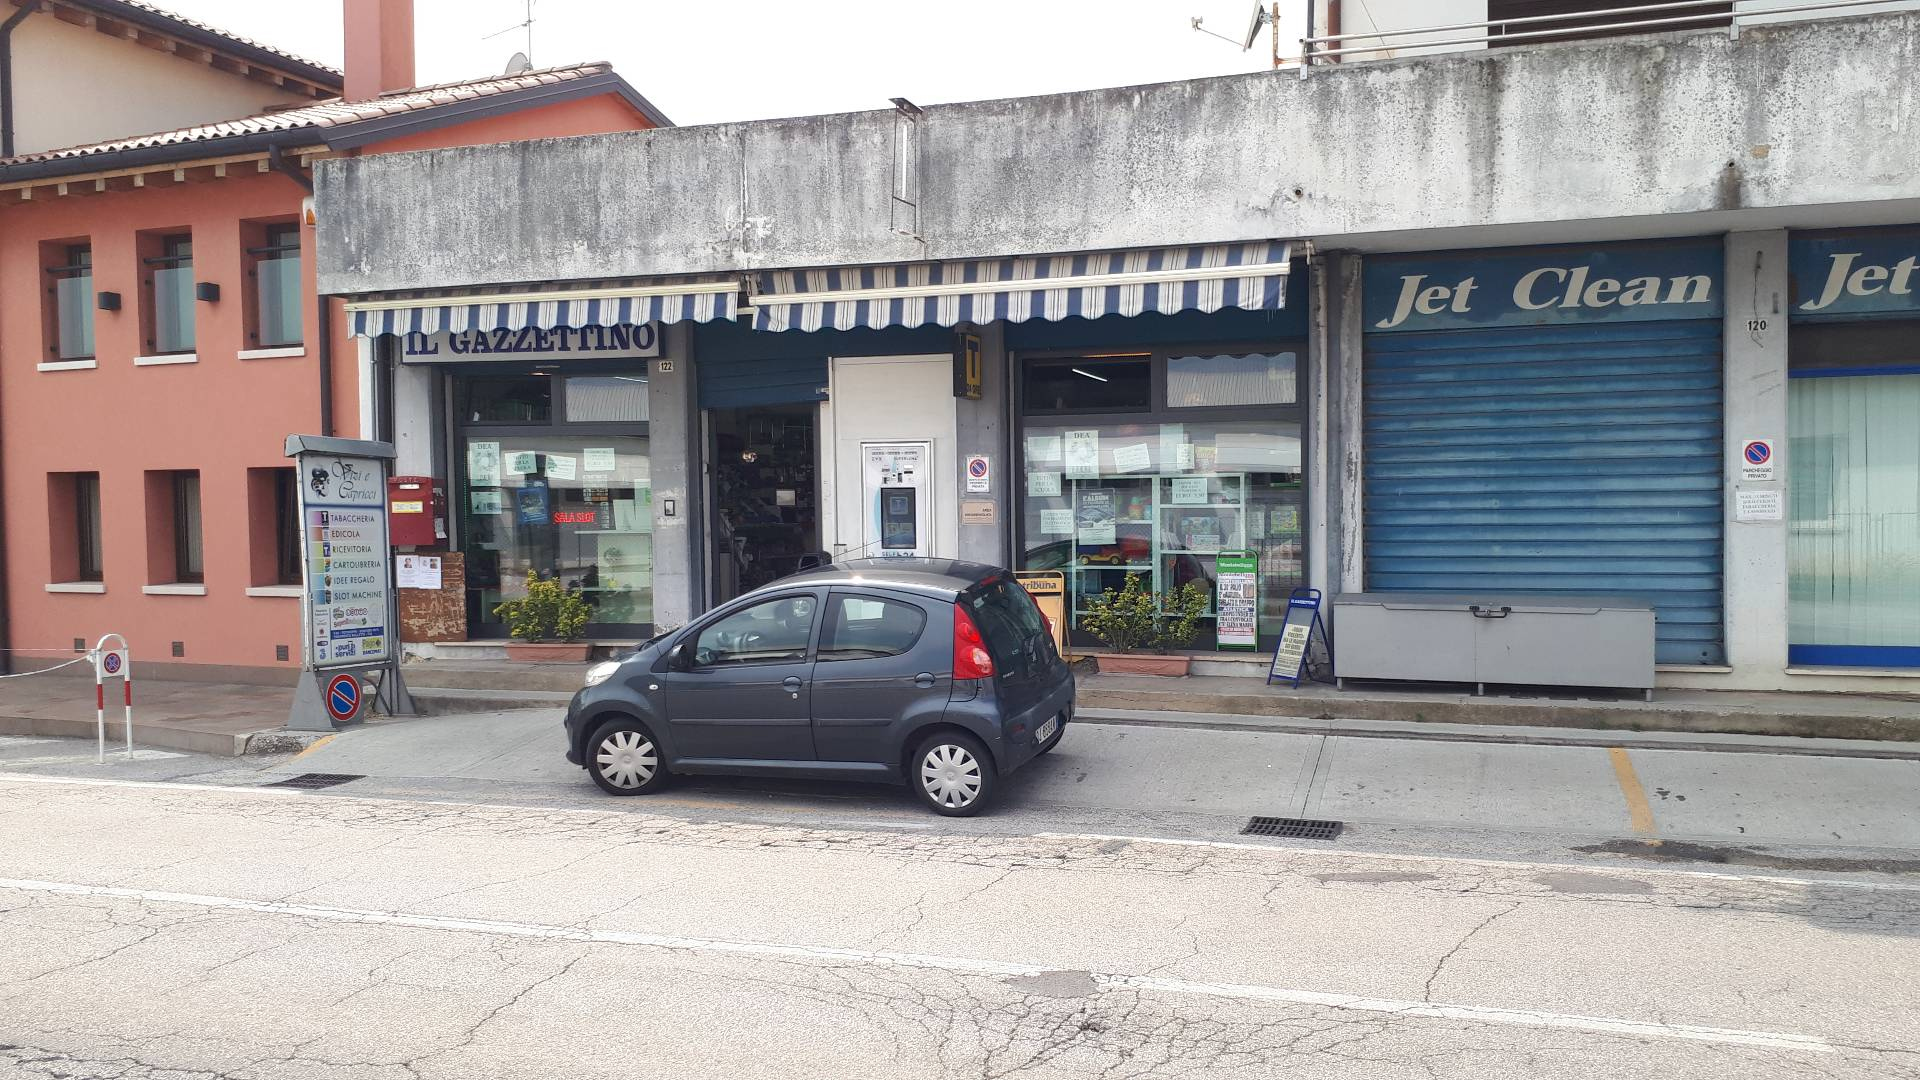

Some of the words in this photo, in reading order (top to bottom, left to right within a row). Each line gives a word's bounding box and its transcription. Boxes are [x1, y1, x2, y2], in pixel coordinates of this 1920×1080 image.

[1799, 253, 1920, 310] Jet
[1375, 275, 1479, 329] Jet
[1513, 266, 1712, 311] Clean
[1748, 320, 1767, 331] 120
[406, 331, 439, 355] IL
[449, 323, 656, 355] GAZZETTINO
[660, 362, 672, 371] 122
[339, 480, 377, 502] Capricci
[330, 515, 375, 523] TABACCHERIA
[331, 530, 360, 538] EDICOLA
[333, 561, 381, 569] CARTOLIBRERIA
[350, 576, 375, 584] REGALO
[1023, 581, 1057, 589] tribuna
[335, 592, 350, 600] SLOT
[352, 591, 382, 599] MACHINE
